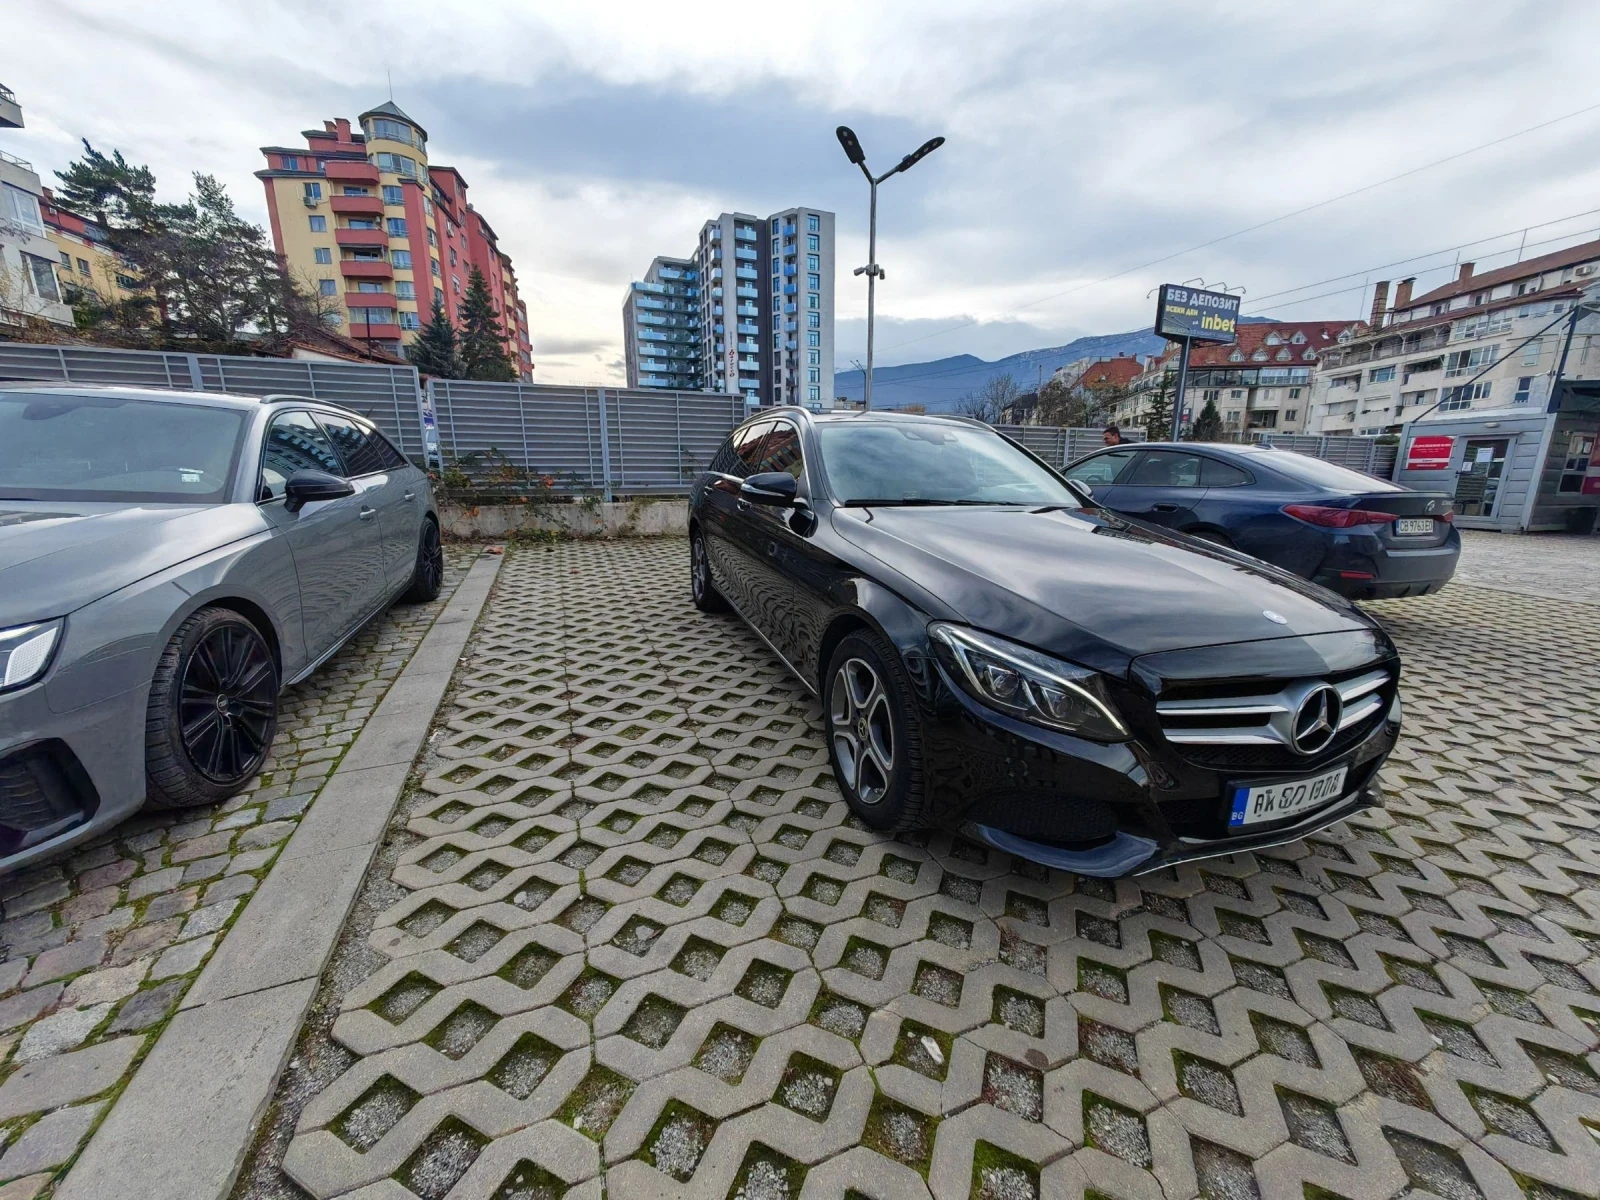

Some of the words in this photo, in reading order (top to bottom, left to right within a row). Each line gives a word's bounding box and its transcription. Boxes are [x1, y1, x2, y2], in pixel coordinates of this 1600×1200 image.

[1167, 288, 1188, 303] БЕЗ
[1189, 293, 1239, 311] ДЕПОЗИТ
[1165, 305, 1185, 314] ВСЕКИ
[1186, 308, 1199, 316] ДЕН
[1201, 311, 1236, 332] inbet
[1410, 520, 1424, 532] 9763
[1231, 811, 1244, 821] BG
